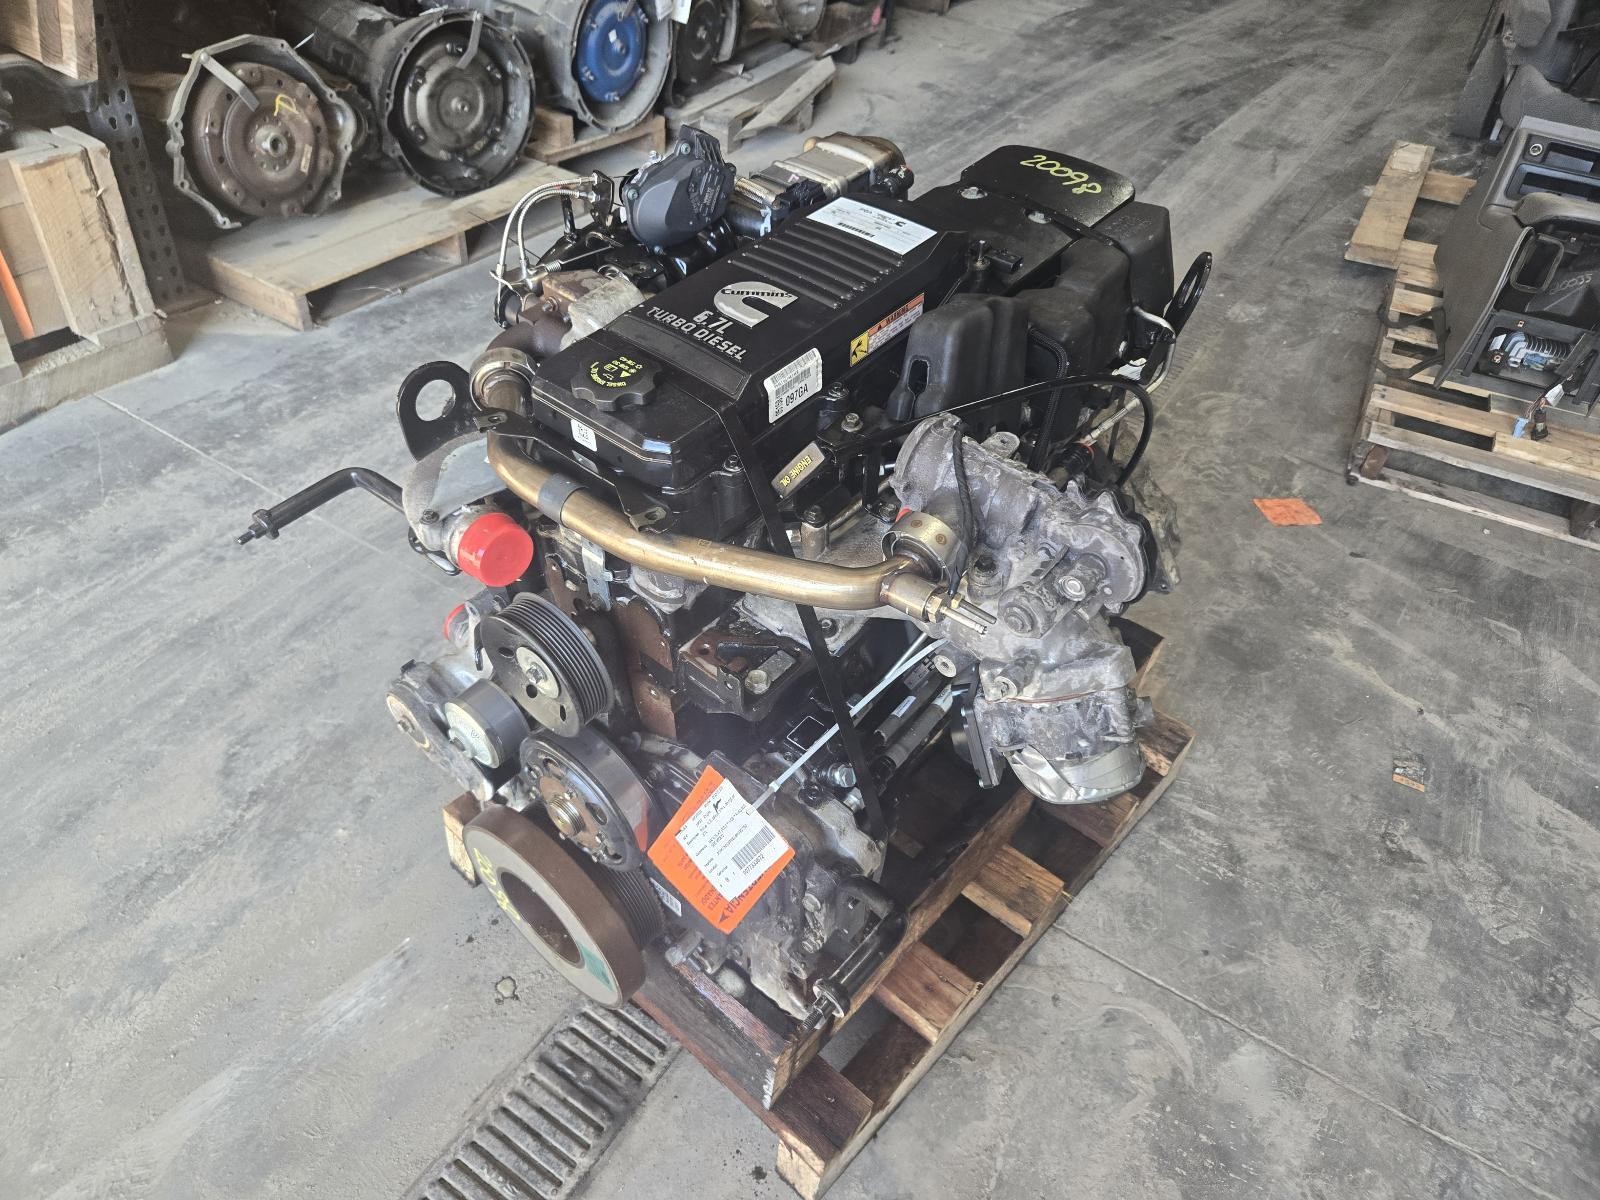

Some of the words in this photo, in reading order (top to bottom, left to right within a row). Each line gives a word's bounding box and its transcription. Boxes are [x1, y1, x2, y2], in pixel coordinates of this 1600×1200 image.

[1020, 154, 1102, 194] 20098
[720, 288, 793, 298] Cummins
[646, 306, 697, 334] TURBO
[693, 328, 748, 361] DIESEL
[692, 310, 734, 335] 6.7L
[785, 384, 809, 406] 097GA
[789, 455, 812, 479] ENGINE
[779, 475, 791, 487] OIL
